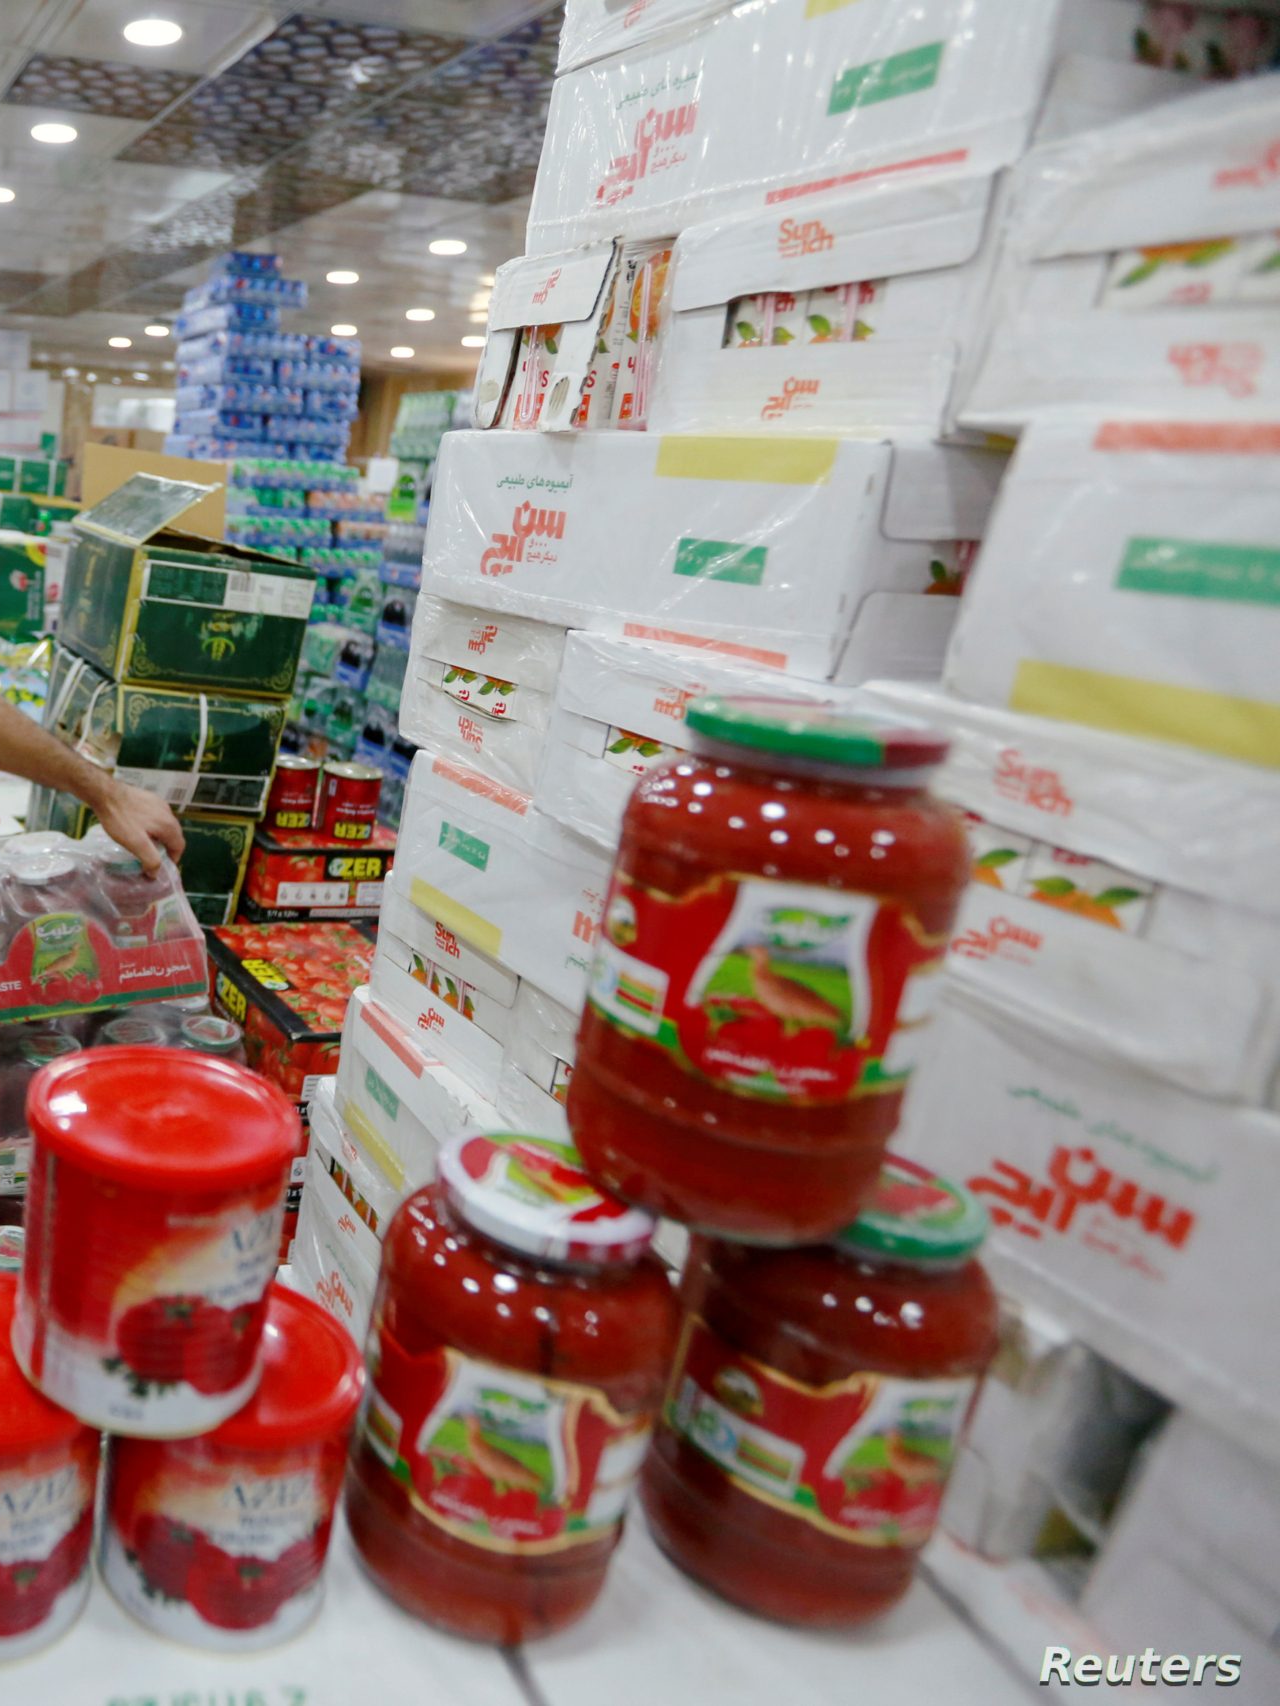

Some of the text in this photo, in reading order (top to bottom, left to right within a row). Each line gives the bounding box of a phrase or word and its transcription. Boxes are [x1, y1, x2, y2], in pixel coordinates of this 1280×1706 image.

[777, 217, 824, 244] Sun
[495, 473, 526, 490] طبیعی
[512, 499, 568, 540] سن
[340, 857, 382, 877] ZER
[434, 920, 456, 945] Sun
[220, 974, 247, 1022] ZER
[1048, 1145, 1195, 1251] سن
